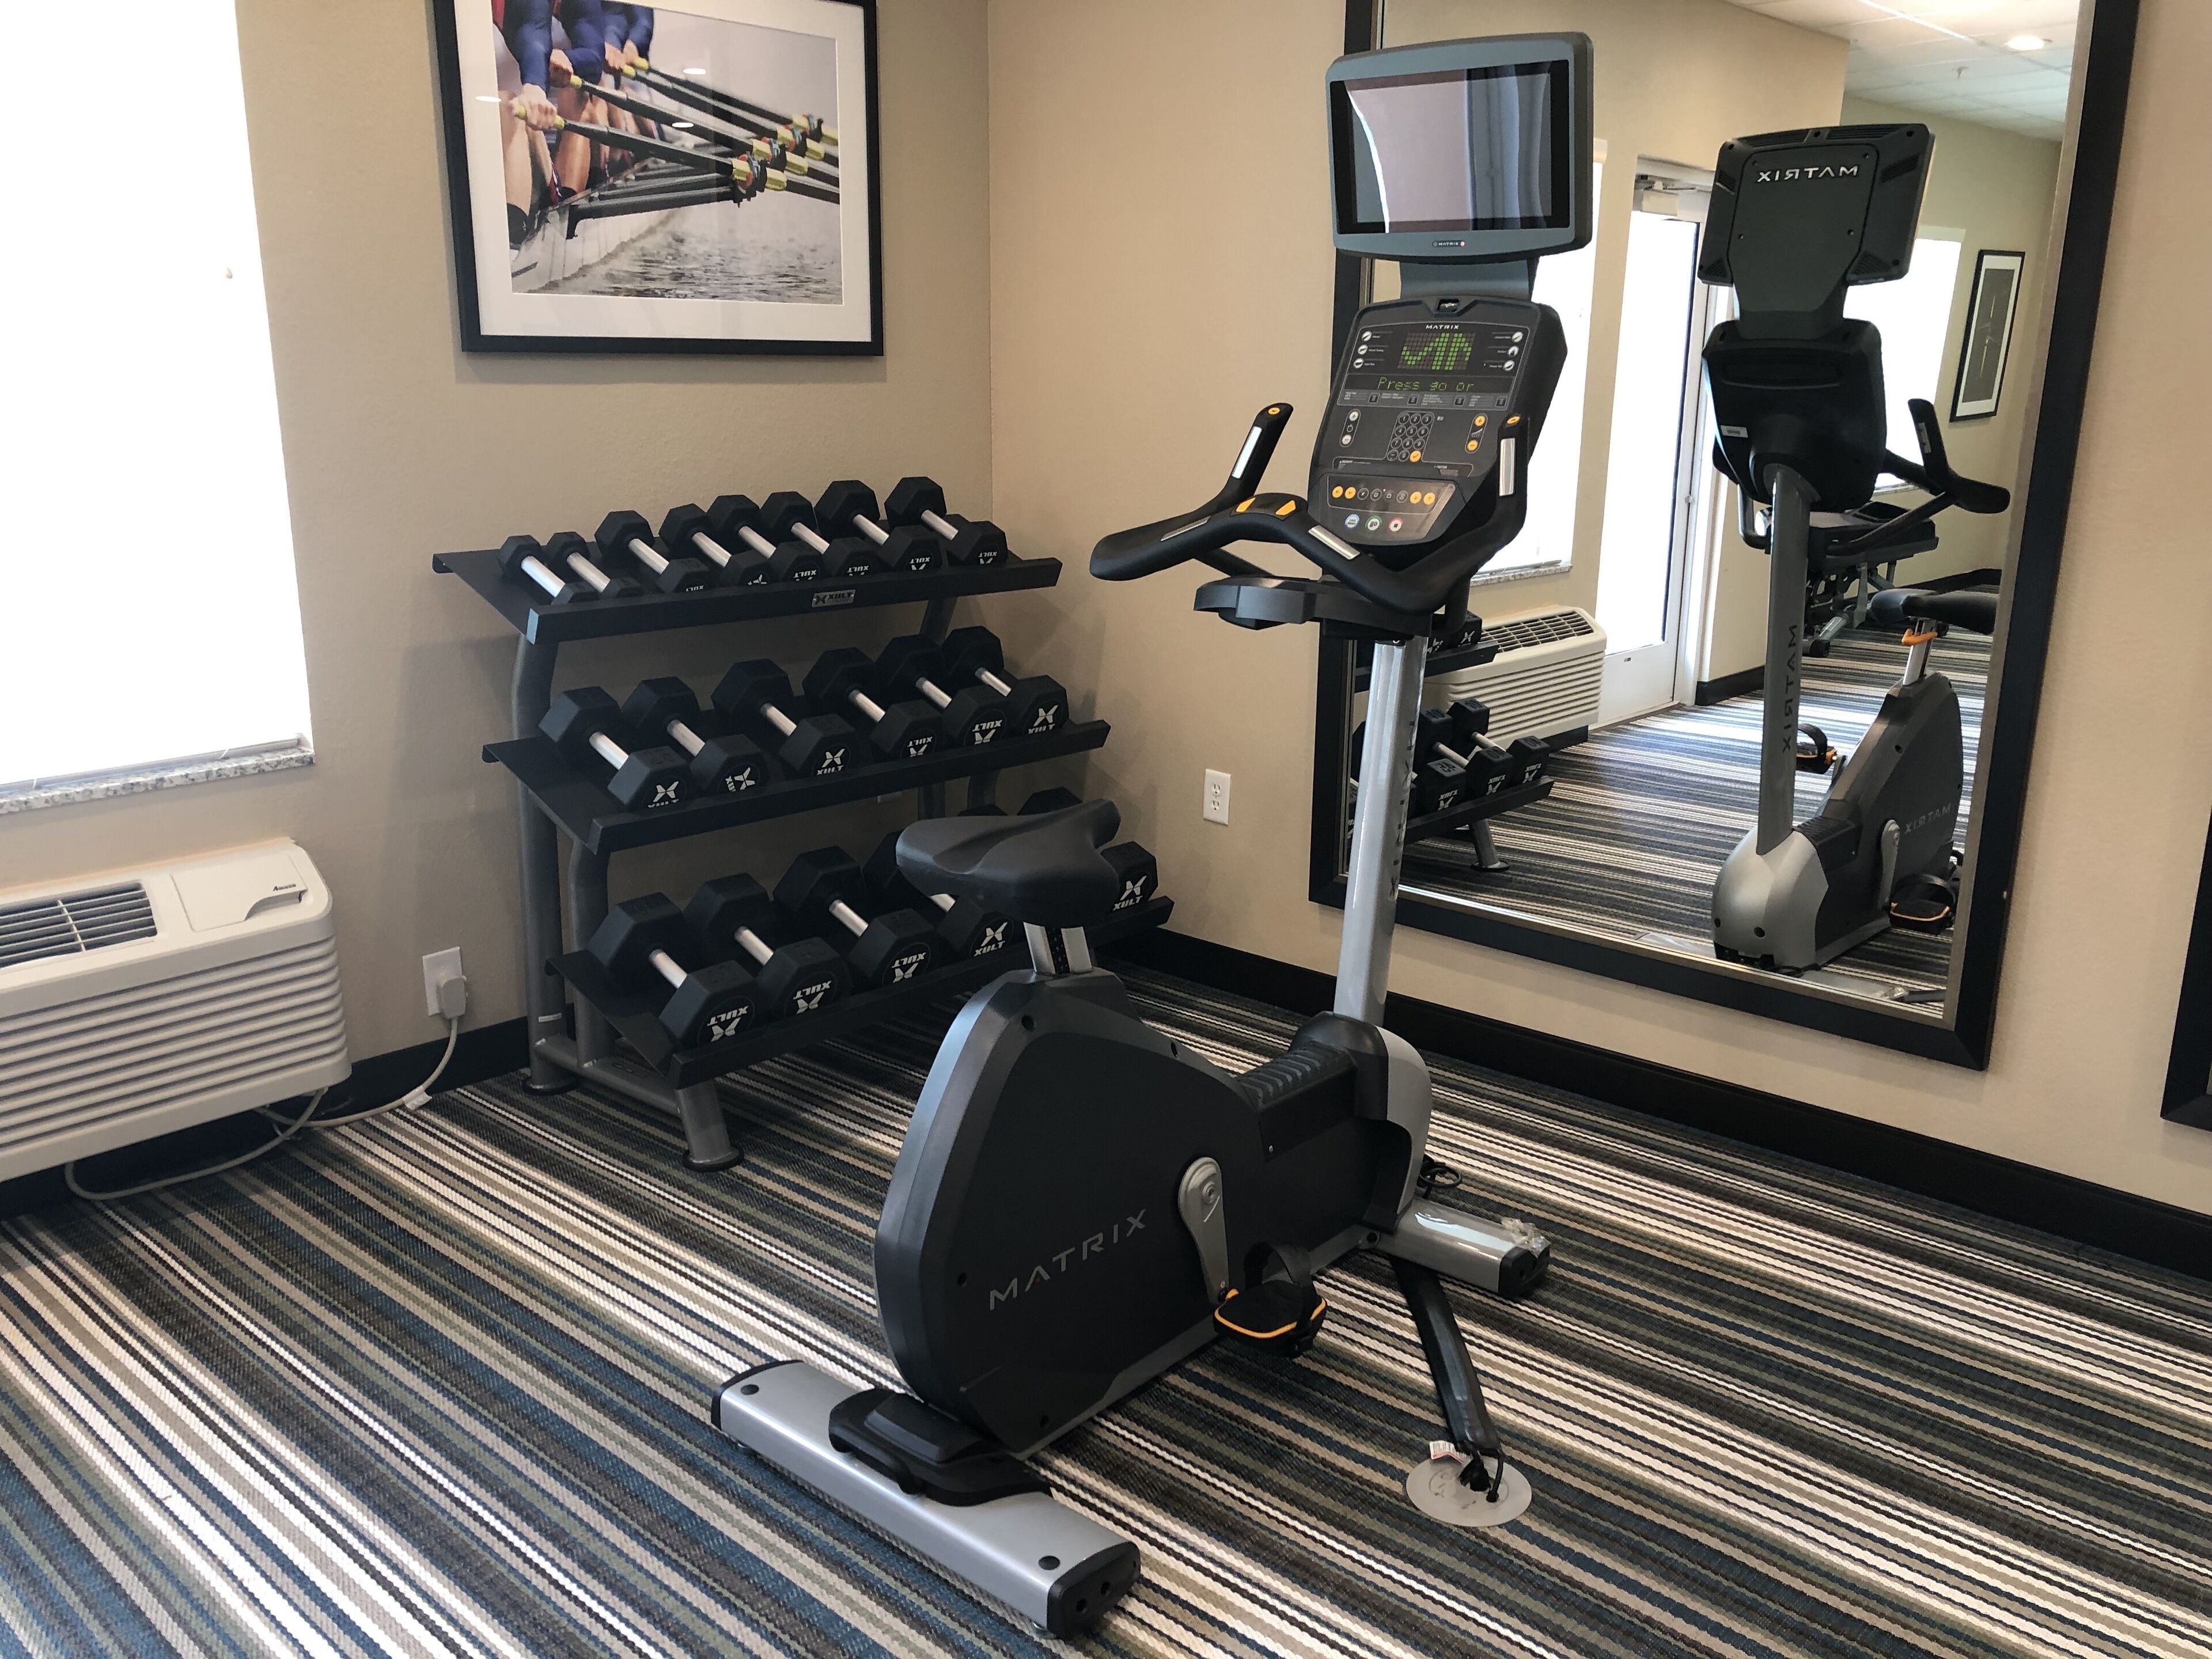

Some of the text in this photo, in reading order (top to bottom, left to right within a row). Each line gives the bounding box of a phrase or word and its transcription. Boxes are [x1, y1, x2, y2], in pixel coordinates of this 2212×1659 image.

[1377, 376, 1420, 391] Press
[1456, 382, 1475, 392] or
[909, 556, 931, 565] XULT
[793, 569, 817, 578] XULT
[847, 565, 869, 573] XULT
[828, 592, 854, 600] XULT
[972, 719, 1003, 733] XULT
[906, 736, 933, 748] XULT
[1112, 895, 1143, 911] XULT
[974, 940, 1006, 957] XULT
[891, 952, 927, 968] XULT
[793, 980, 832, 1001] XULT
[706, 1005, 749, 1027] XULT
[989, 1208, 1147, 1311] MATRIX
